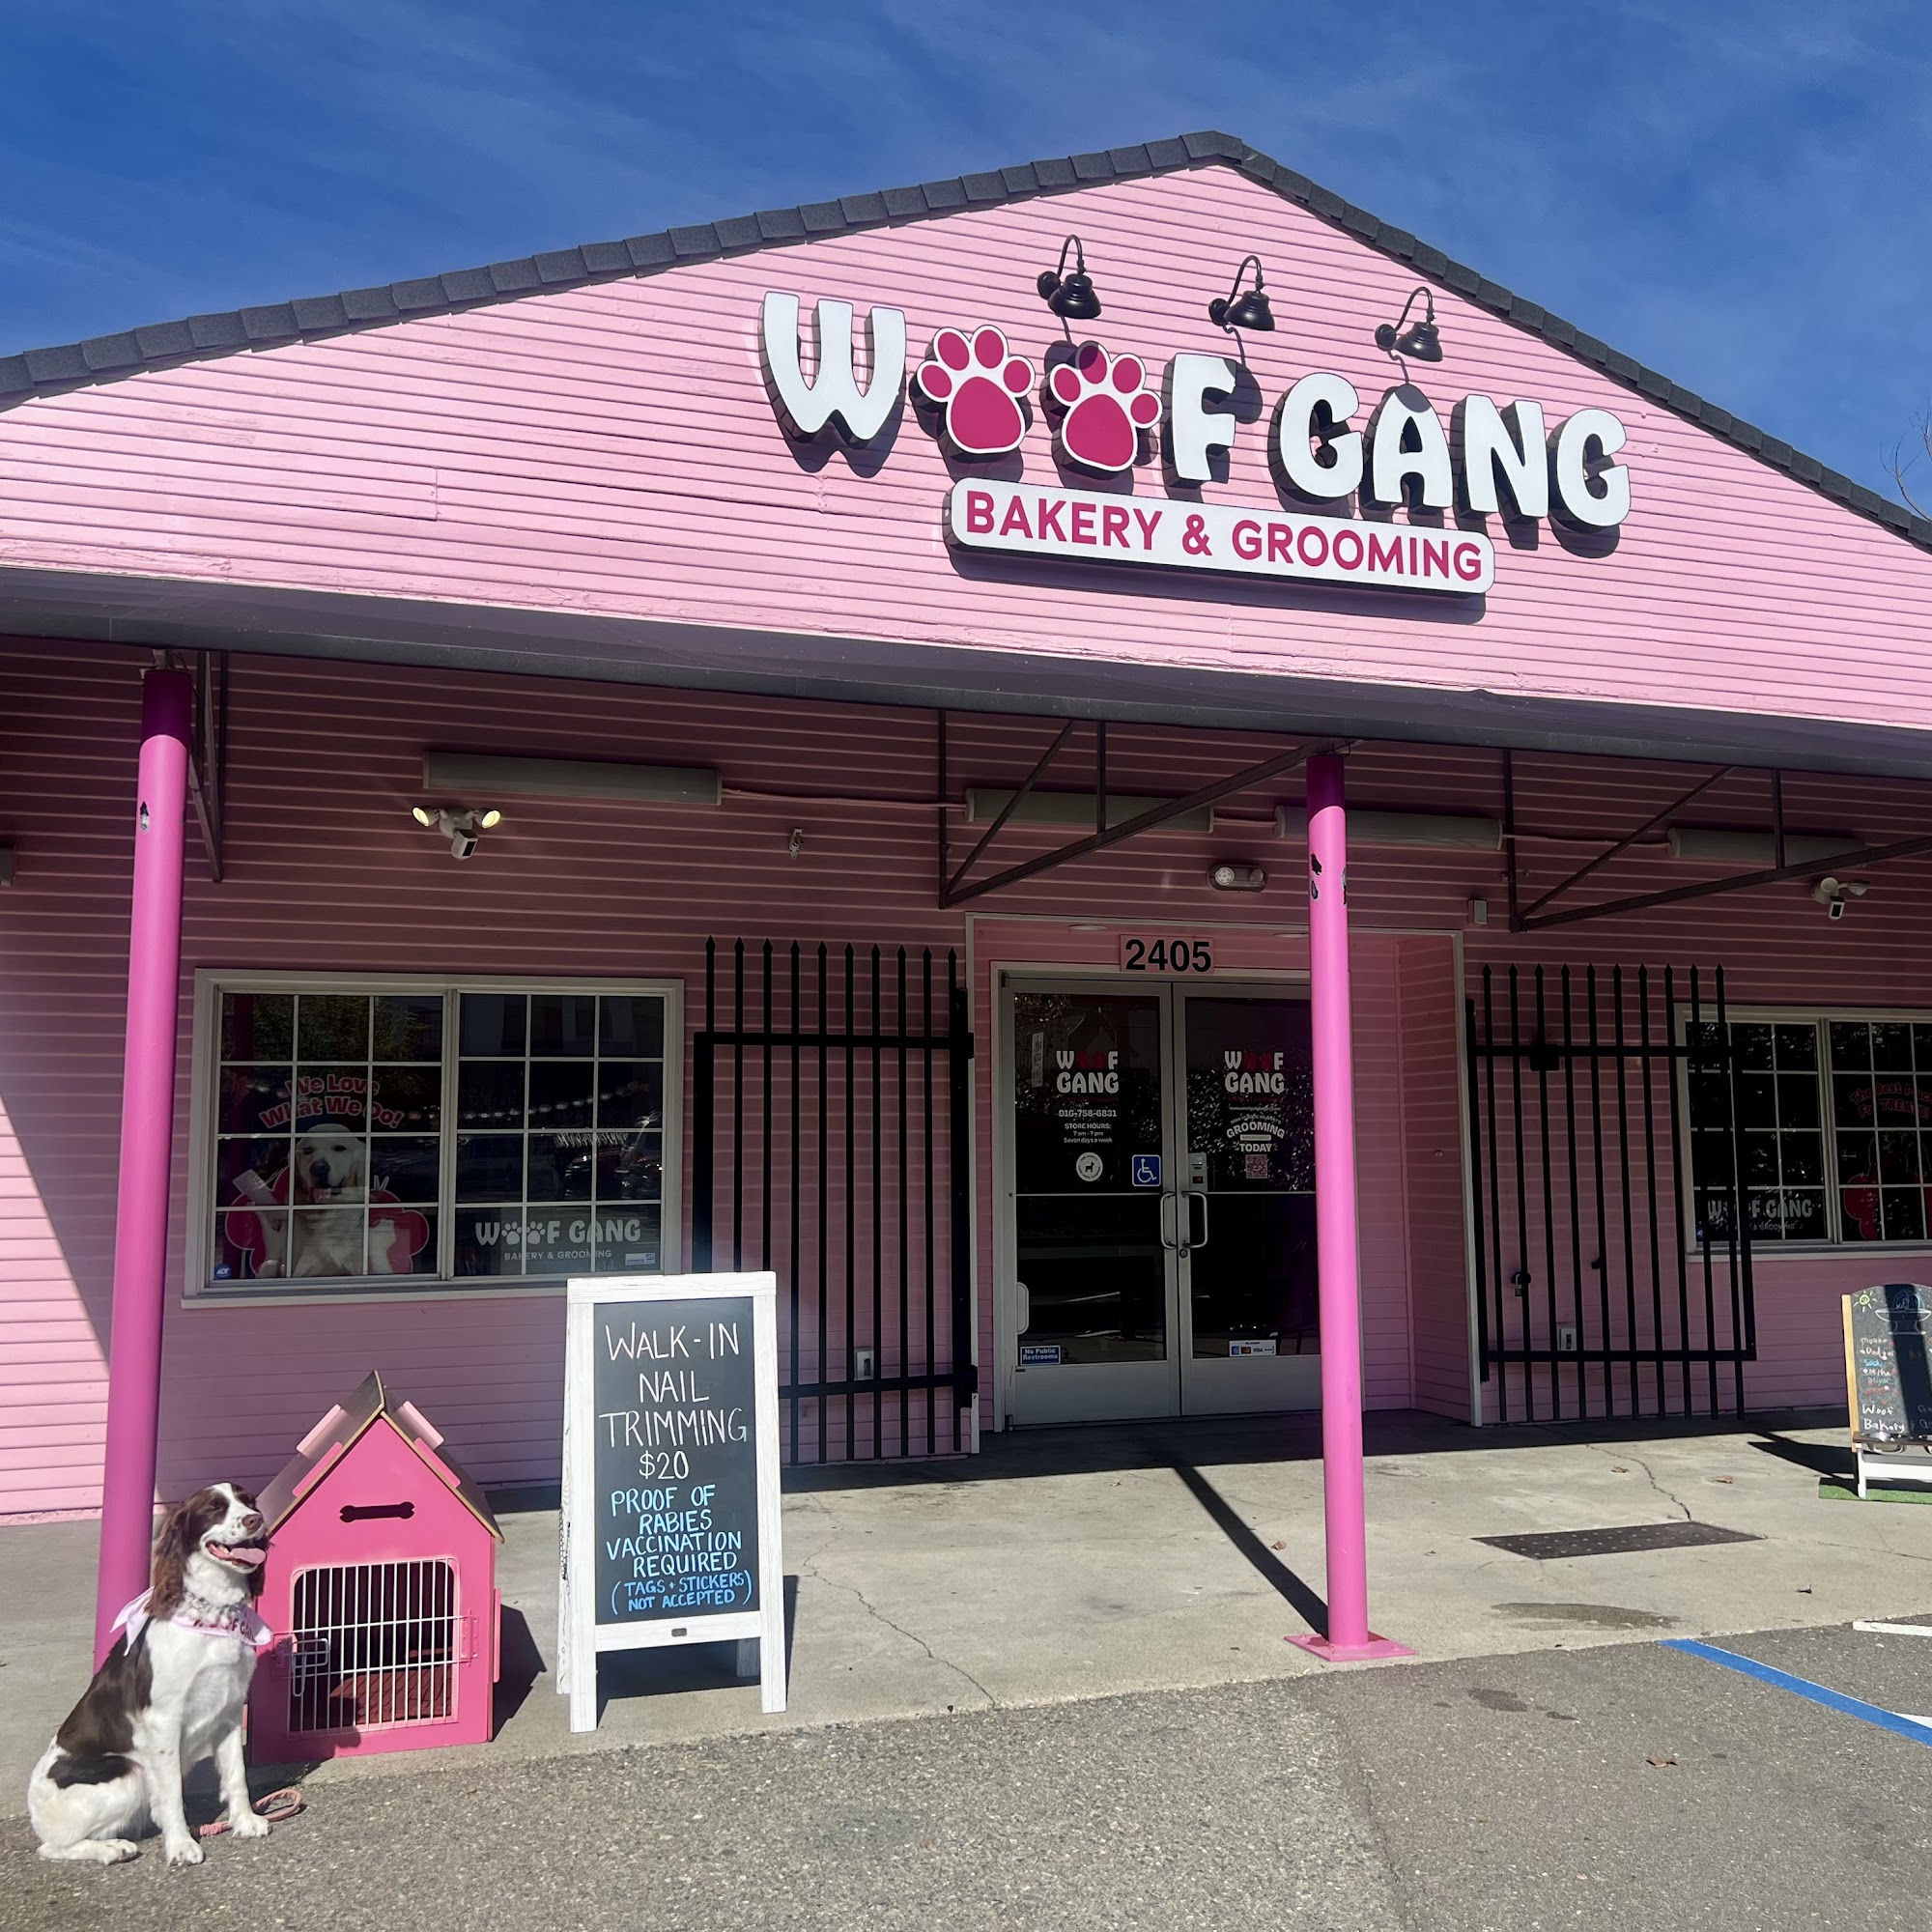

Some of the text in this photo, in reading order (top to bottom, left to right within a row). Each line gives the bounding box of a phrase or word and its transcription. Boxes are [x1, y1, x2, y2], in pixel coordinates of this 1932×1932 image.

[762, 290, 1633, 528] WF GANG
[965, 490, 1483, 582] BAKERY & GROOMING
[1124, 938, 1212, 974] 2405
[284, 1073, 381, 1096] We Love
[1056, 1071, 1120, 1094] GANG
[1224, 1071, 1286, 1094] GANG
[258, 1096, 324, 1129] What
[324, 1095, 363, 1117] We
[1226, 1121, 1286, 1140] GROOMING
[1238, 1143, 1273, 1152] TODAY
[568, 1218, 641, 1243] GANG
[639, 1370, 710, 1404] NAIL
[1861, 1404, 1893, 1416] Woof
[598, 1406, 748, 1448] TRIMMING
[639, 1449, 690, 1480] $20
[611, 1484, 716, 1517] PROOF OF
[639, 1509, 713, 1535] RABIES
[606, 1530, 742, 1561] VACCINATION
[633, 1550, 738, 1578] REQUIRED
[628, 1596, 656, 1612] NOT
